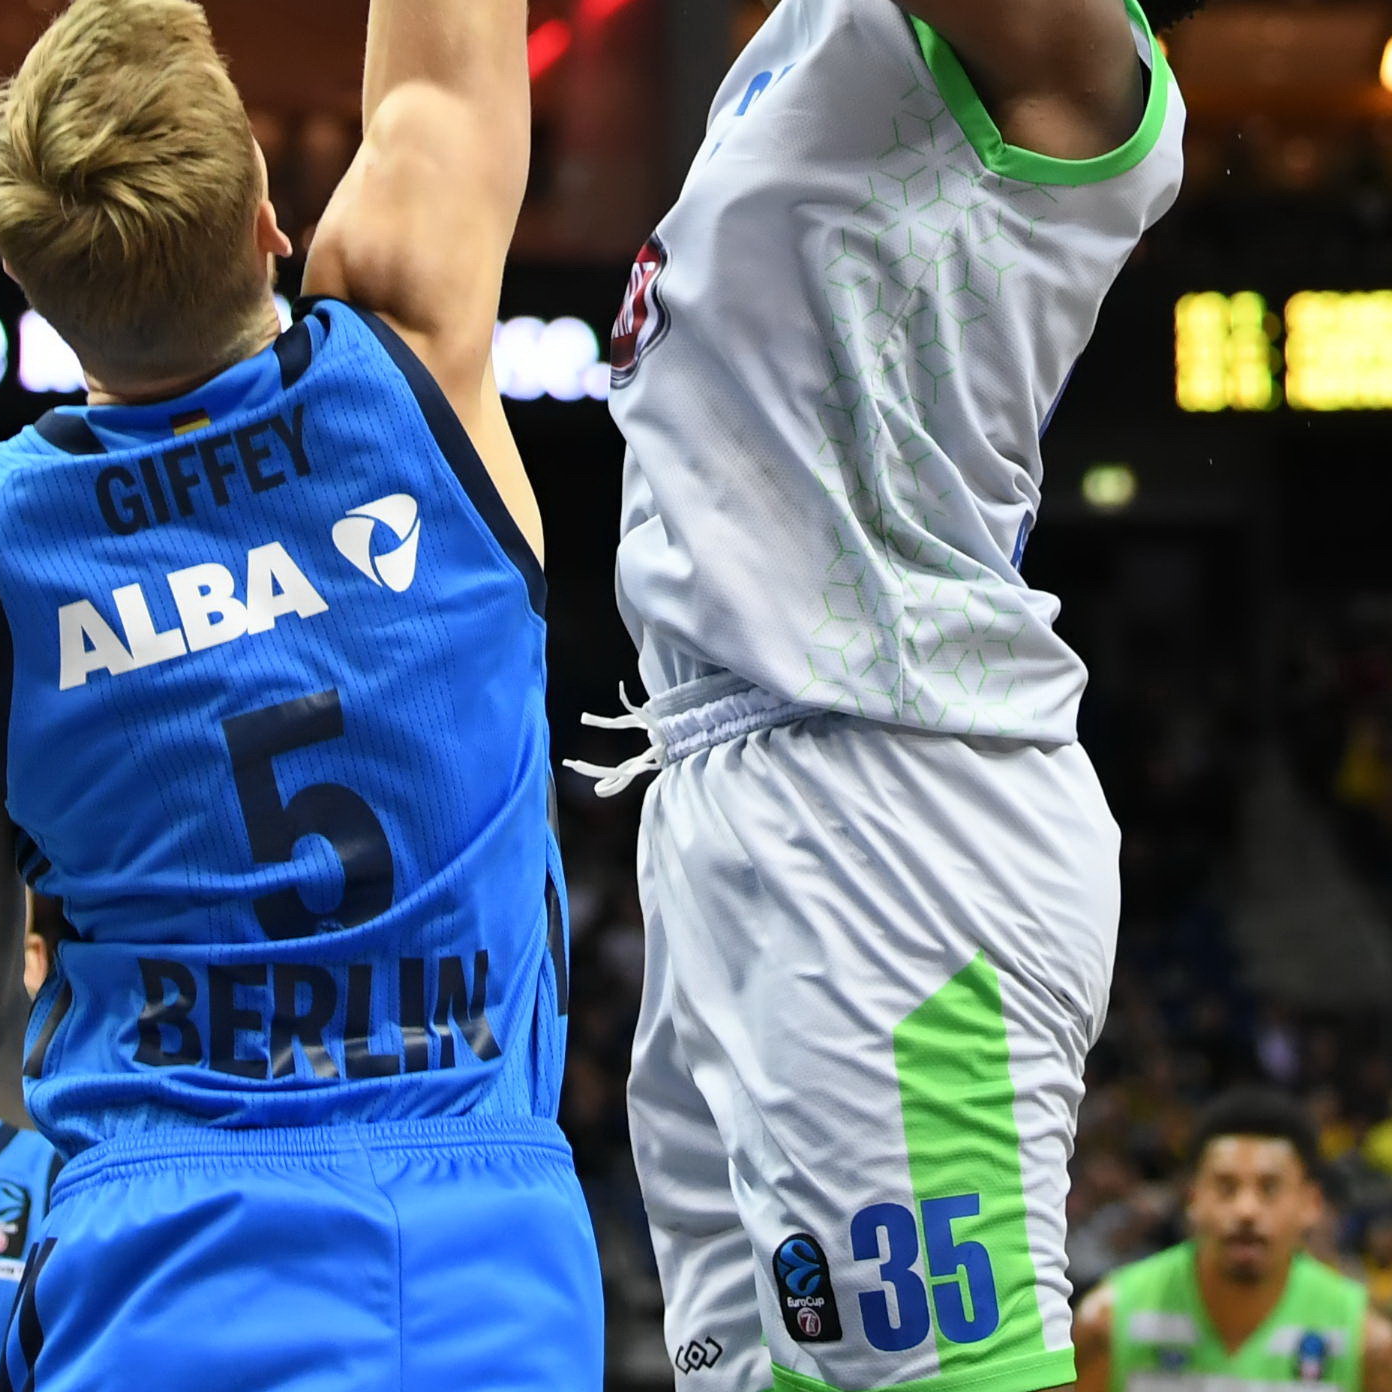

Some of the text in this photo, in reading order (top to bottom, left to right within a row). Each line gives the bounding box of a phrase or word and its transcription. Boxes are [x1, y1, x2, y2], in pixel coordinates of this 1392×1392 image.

[95, 403, 312, 536] GIFFEY
[58, 541, 329, 691] ALBA
[221, 691, 395, 941] 5
[135, 949, 501, 1081] BERLIN
[786, 1296, 826, 1308] EuroCup
[850, 1194, 999, 1352] 35
